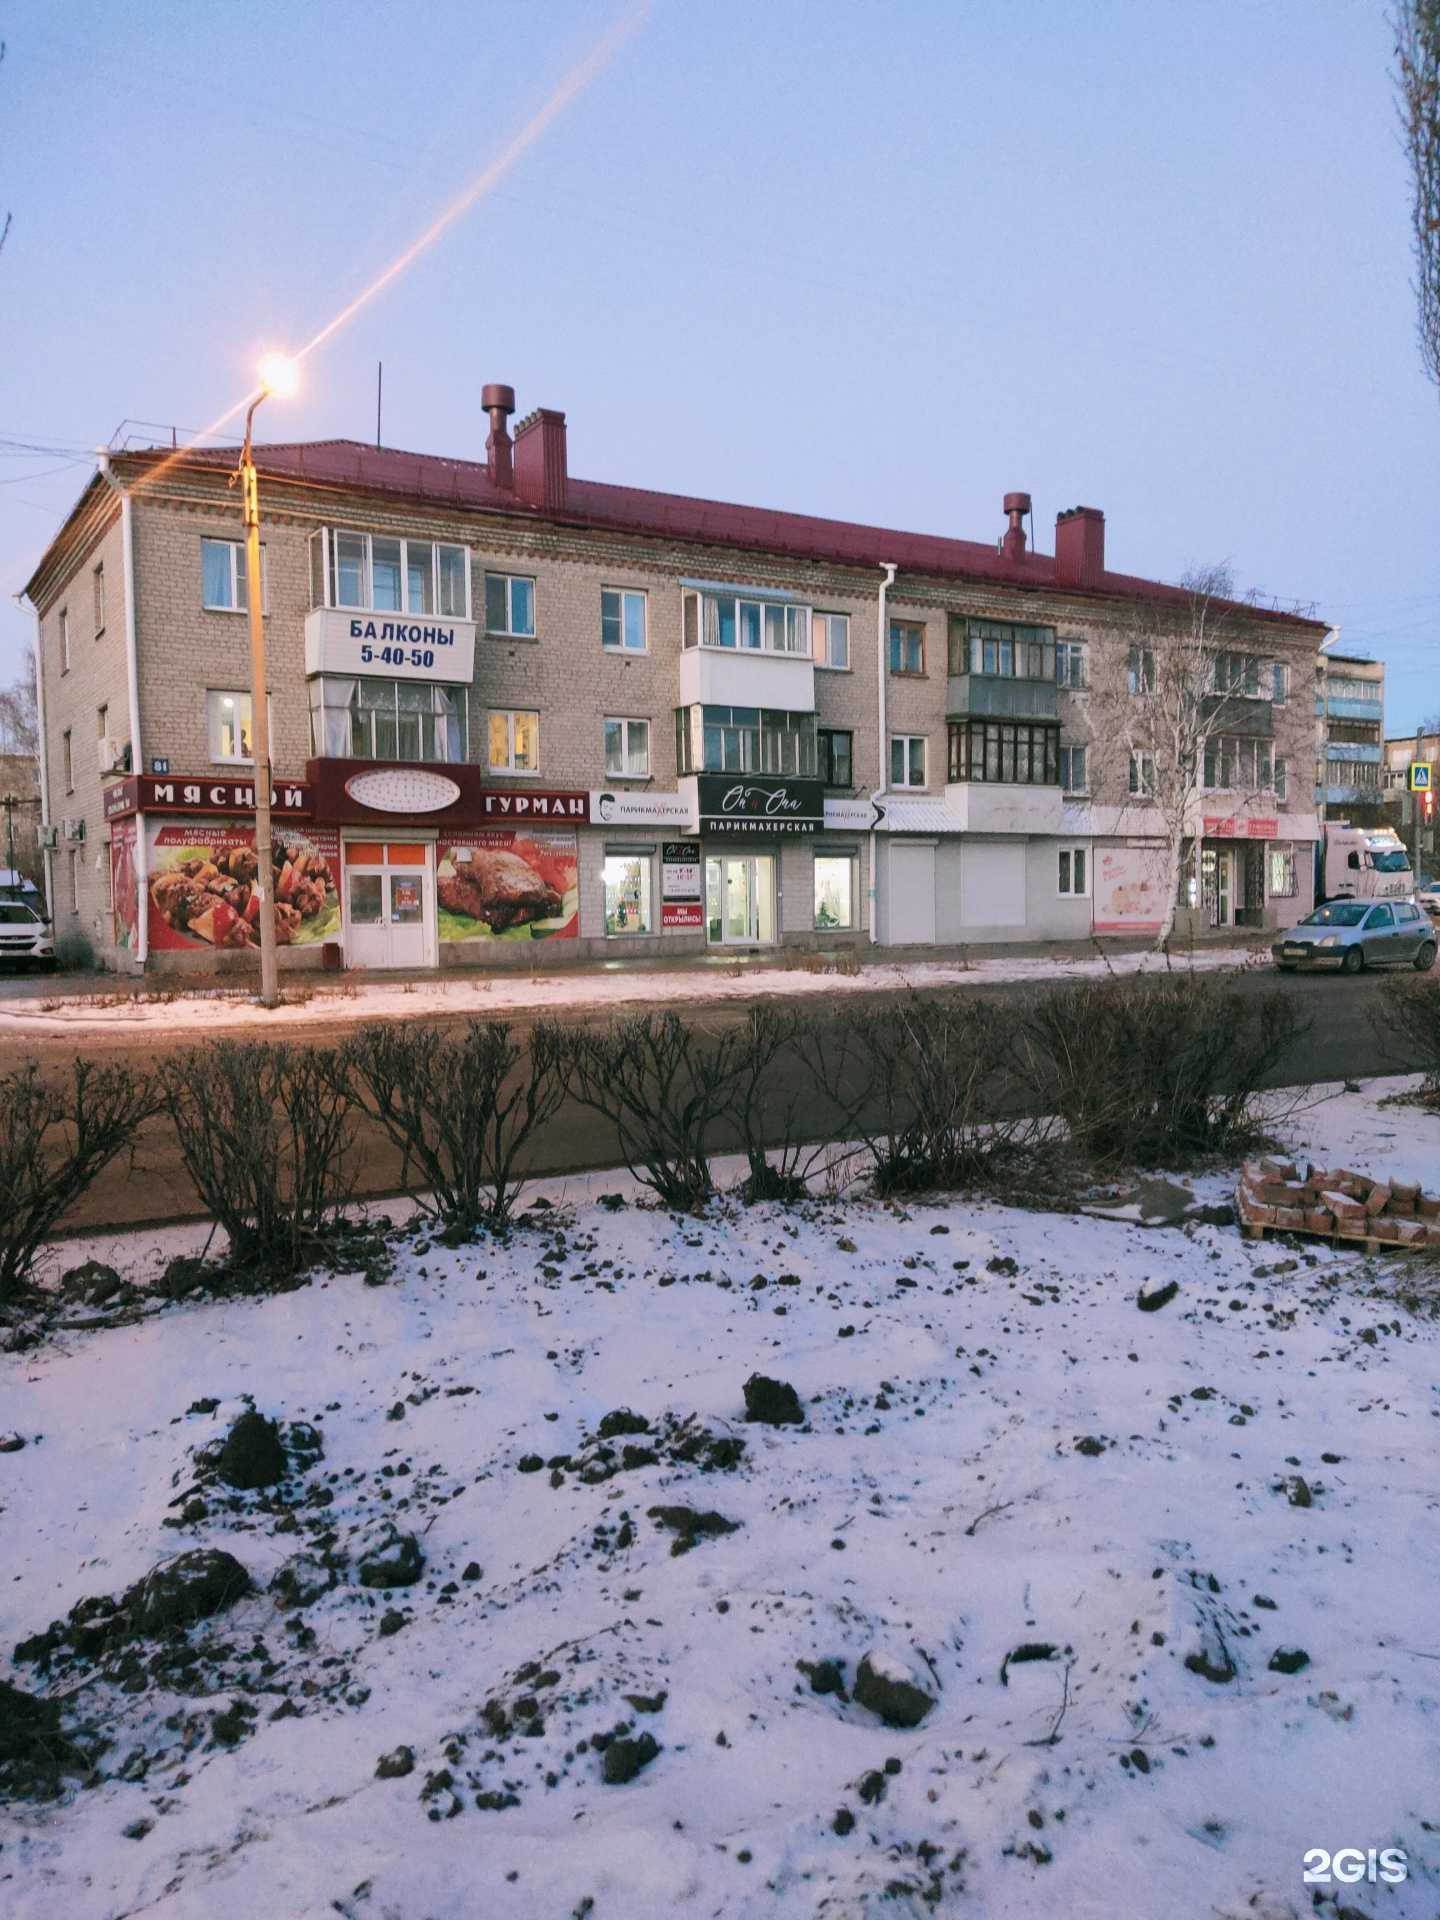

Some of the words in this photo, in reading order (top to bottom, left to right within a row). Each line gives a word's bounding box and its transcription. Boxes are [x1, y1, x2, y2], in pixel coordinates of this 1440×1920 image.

[350, 619, 454, 646] БАЛКОНЫ
[361, 644, 434, 668] 5-40-50
[153, 760, 167, 773] 81
[485, 796, 584, 815] ГУРМАН
[620, 804, 689, 816] ПАРИКМАХЕРСКАЯ
[709, 821, 814, 833] ПАРИКМАХЕРСКАЯ
